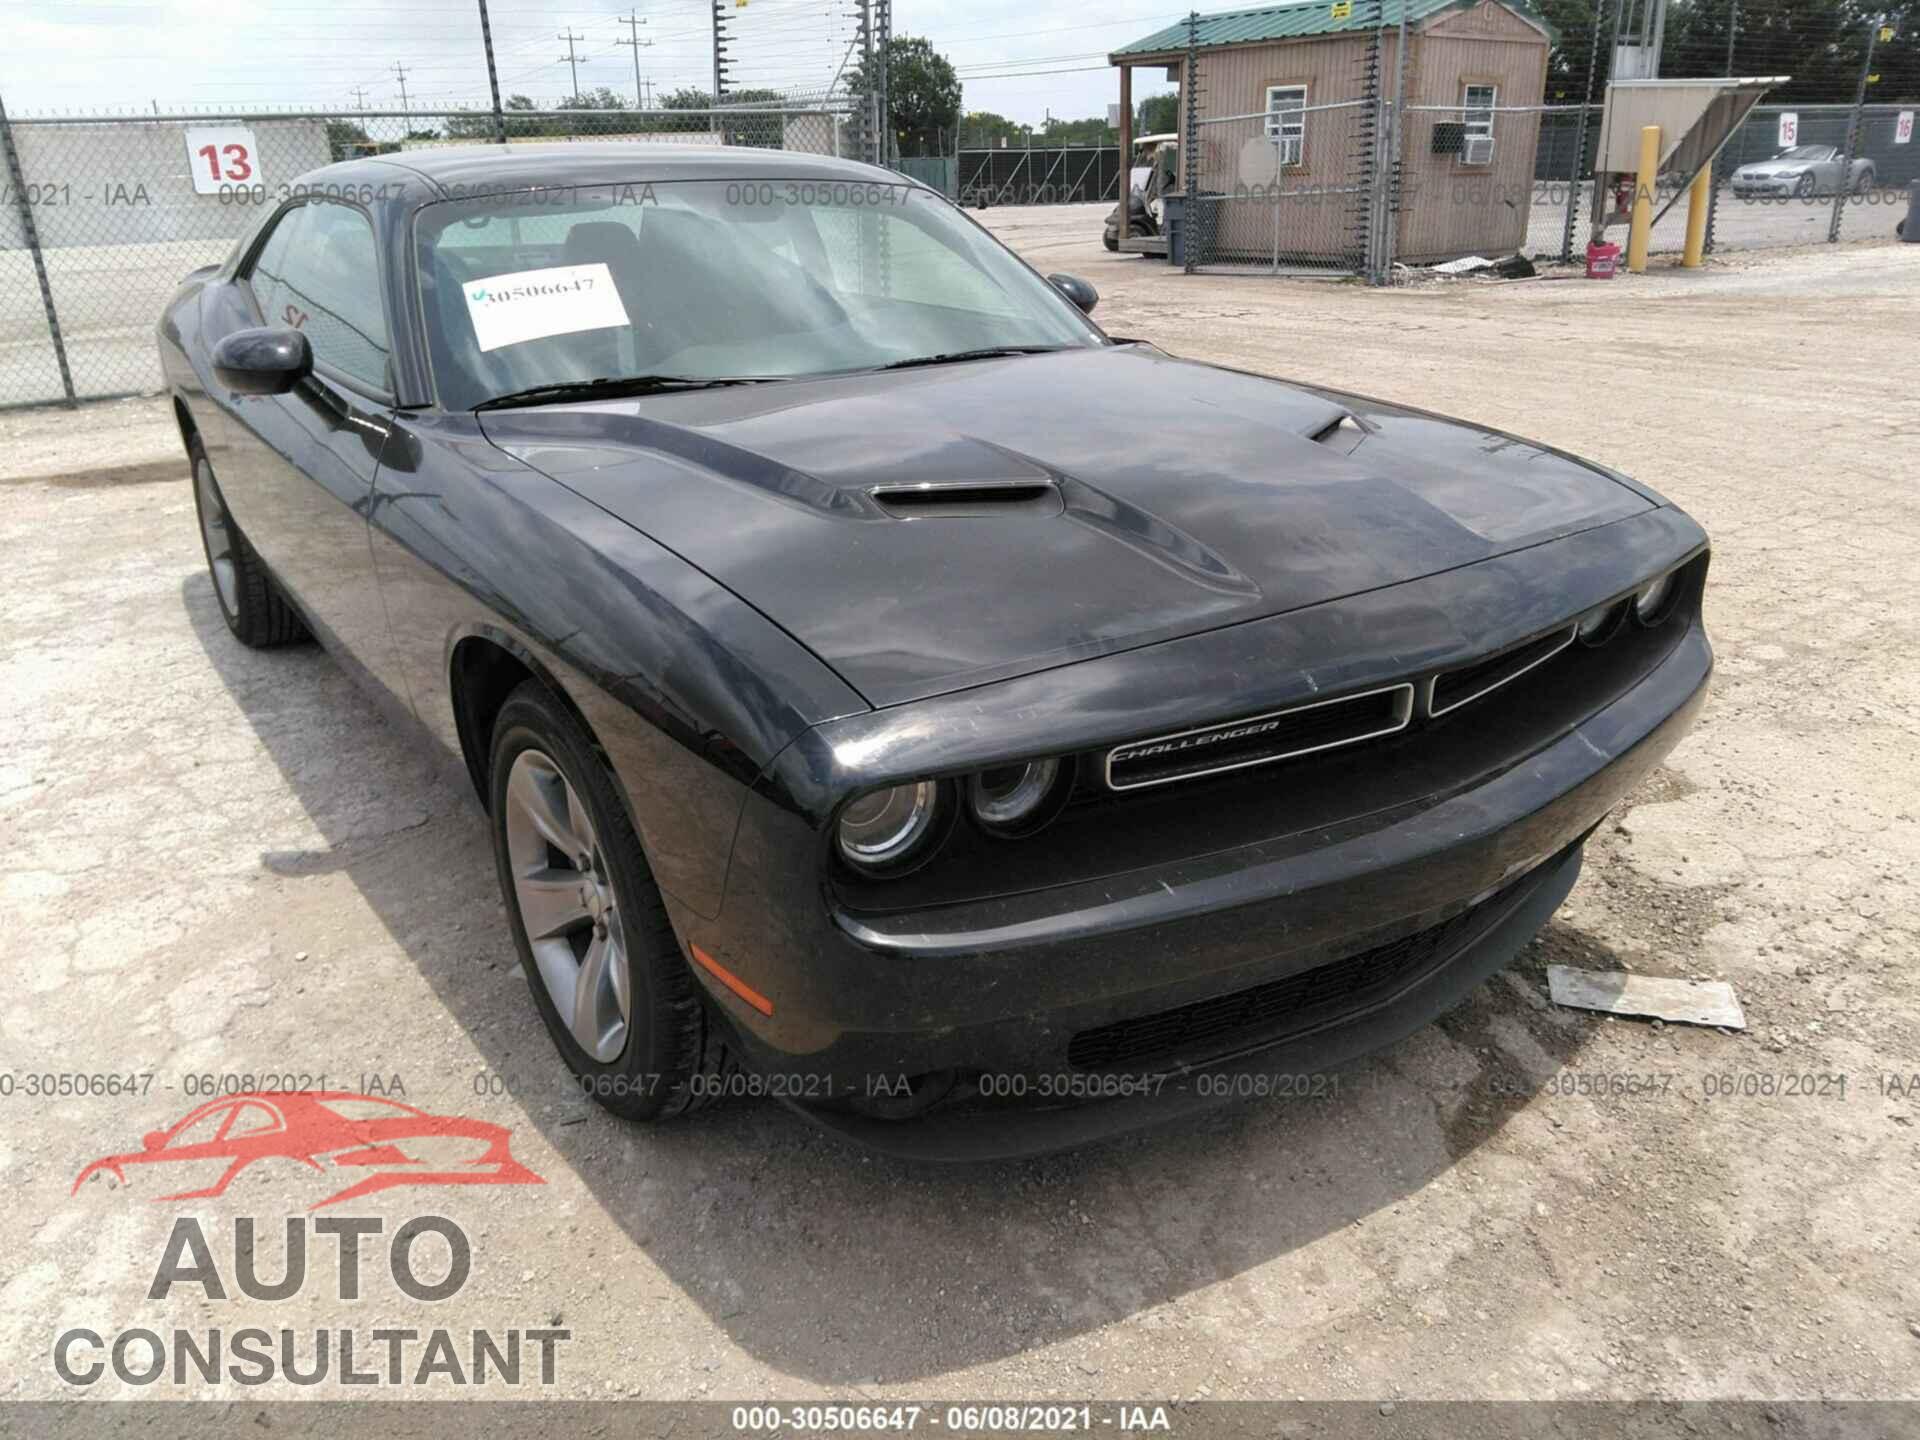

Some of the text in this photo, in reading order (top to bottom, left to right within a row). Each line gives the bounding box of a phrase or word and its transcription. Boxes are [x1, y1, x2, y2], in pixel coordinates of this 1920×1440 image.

[1782, 120, 1796, 141] 15
[199, 144, 252, 181] 13
[486, 278, 594, 306] 30506647
[1111, 721, 1280, 763] CHALLENGER
